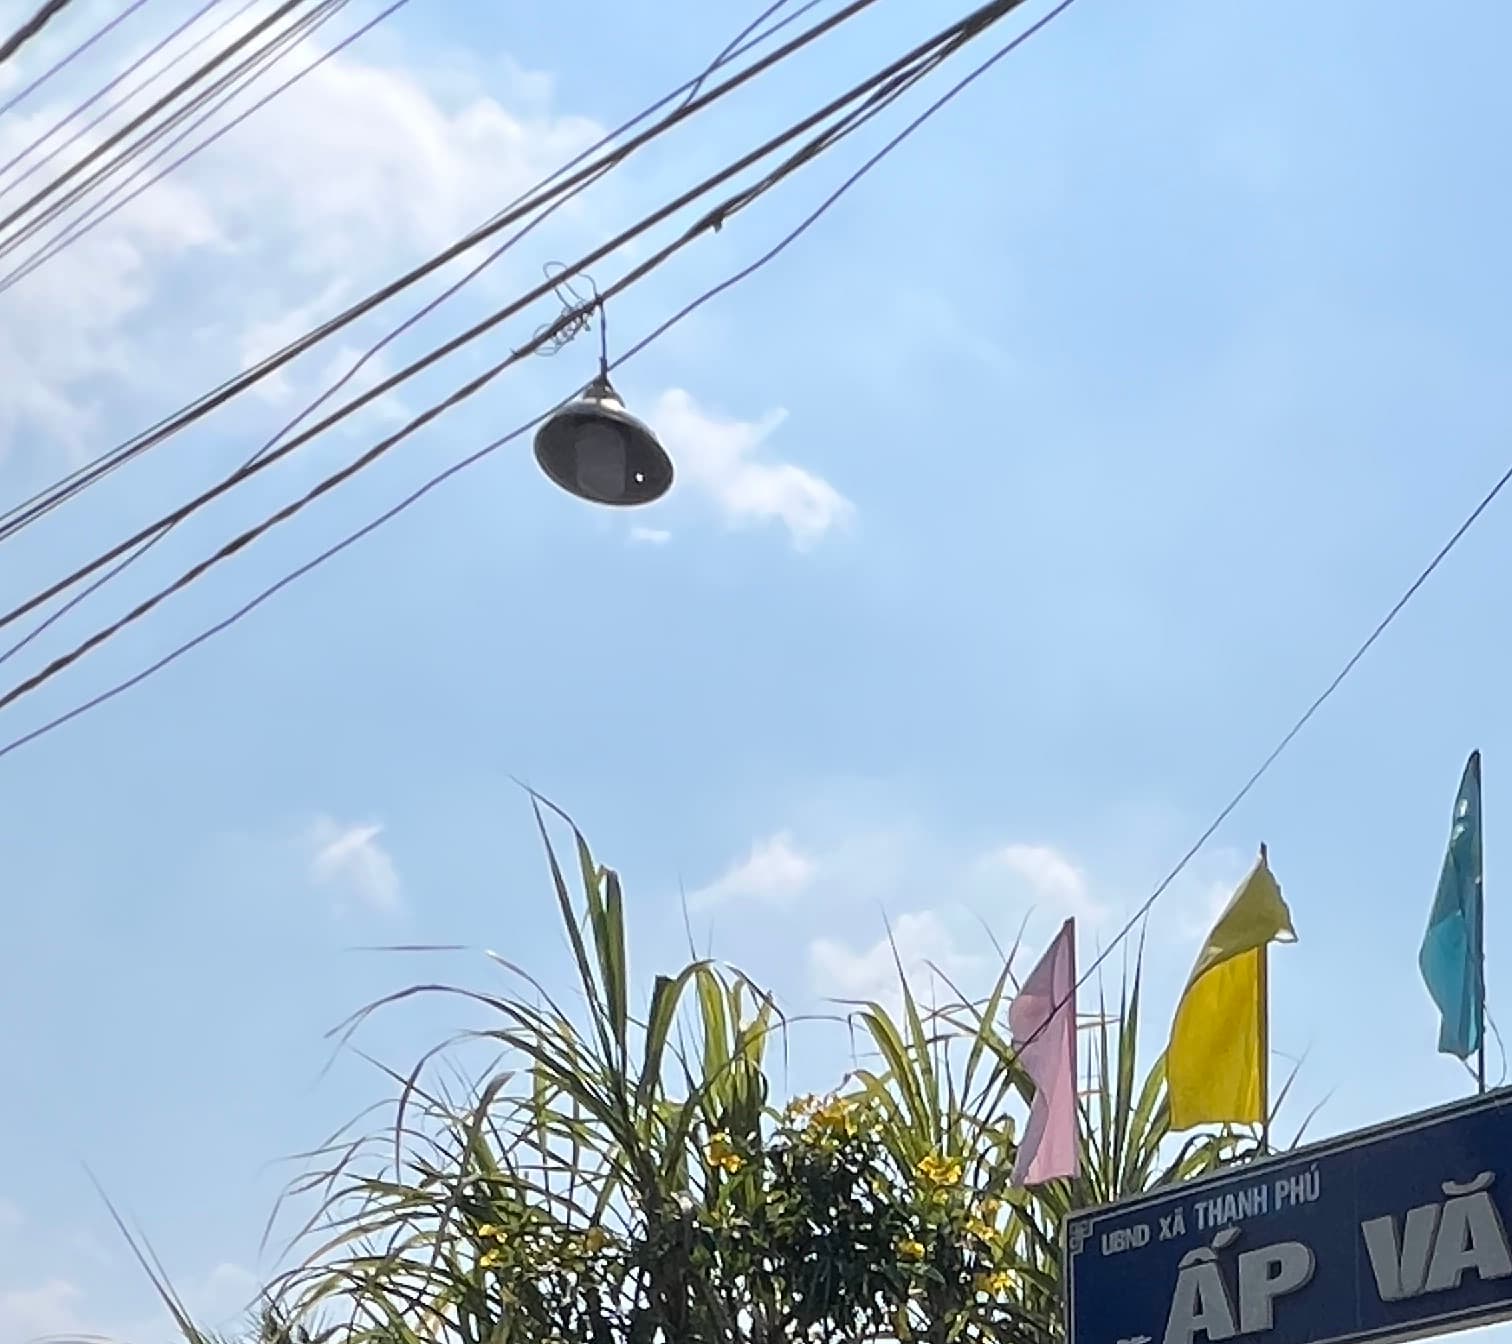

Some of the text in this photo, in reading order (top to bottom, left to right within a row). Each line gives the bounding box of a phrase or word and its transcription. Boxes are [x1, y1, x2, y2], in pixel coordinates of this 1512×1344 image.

[1101, 1223, 1150, 1256] UBND
[1158, 1206, 1186, 1241] XÃ
[1274, 1162, 1320, 1211] PHÚ
